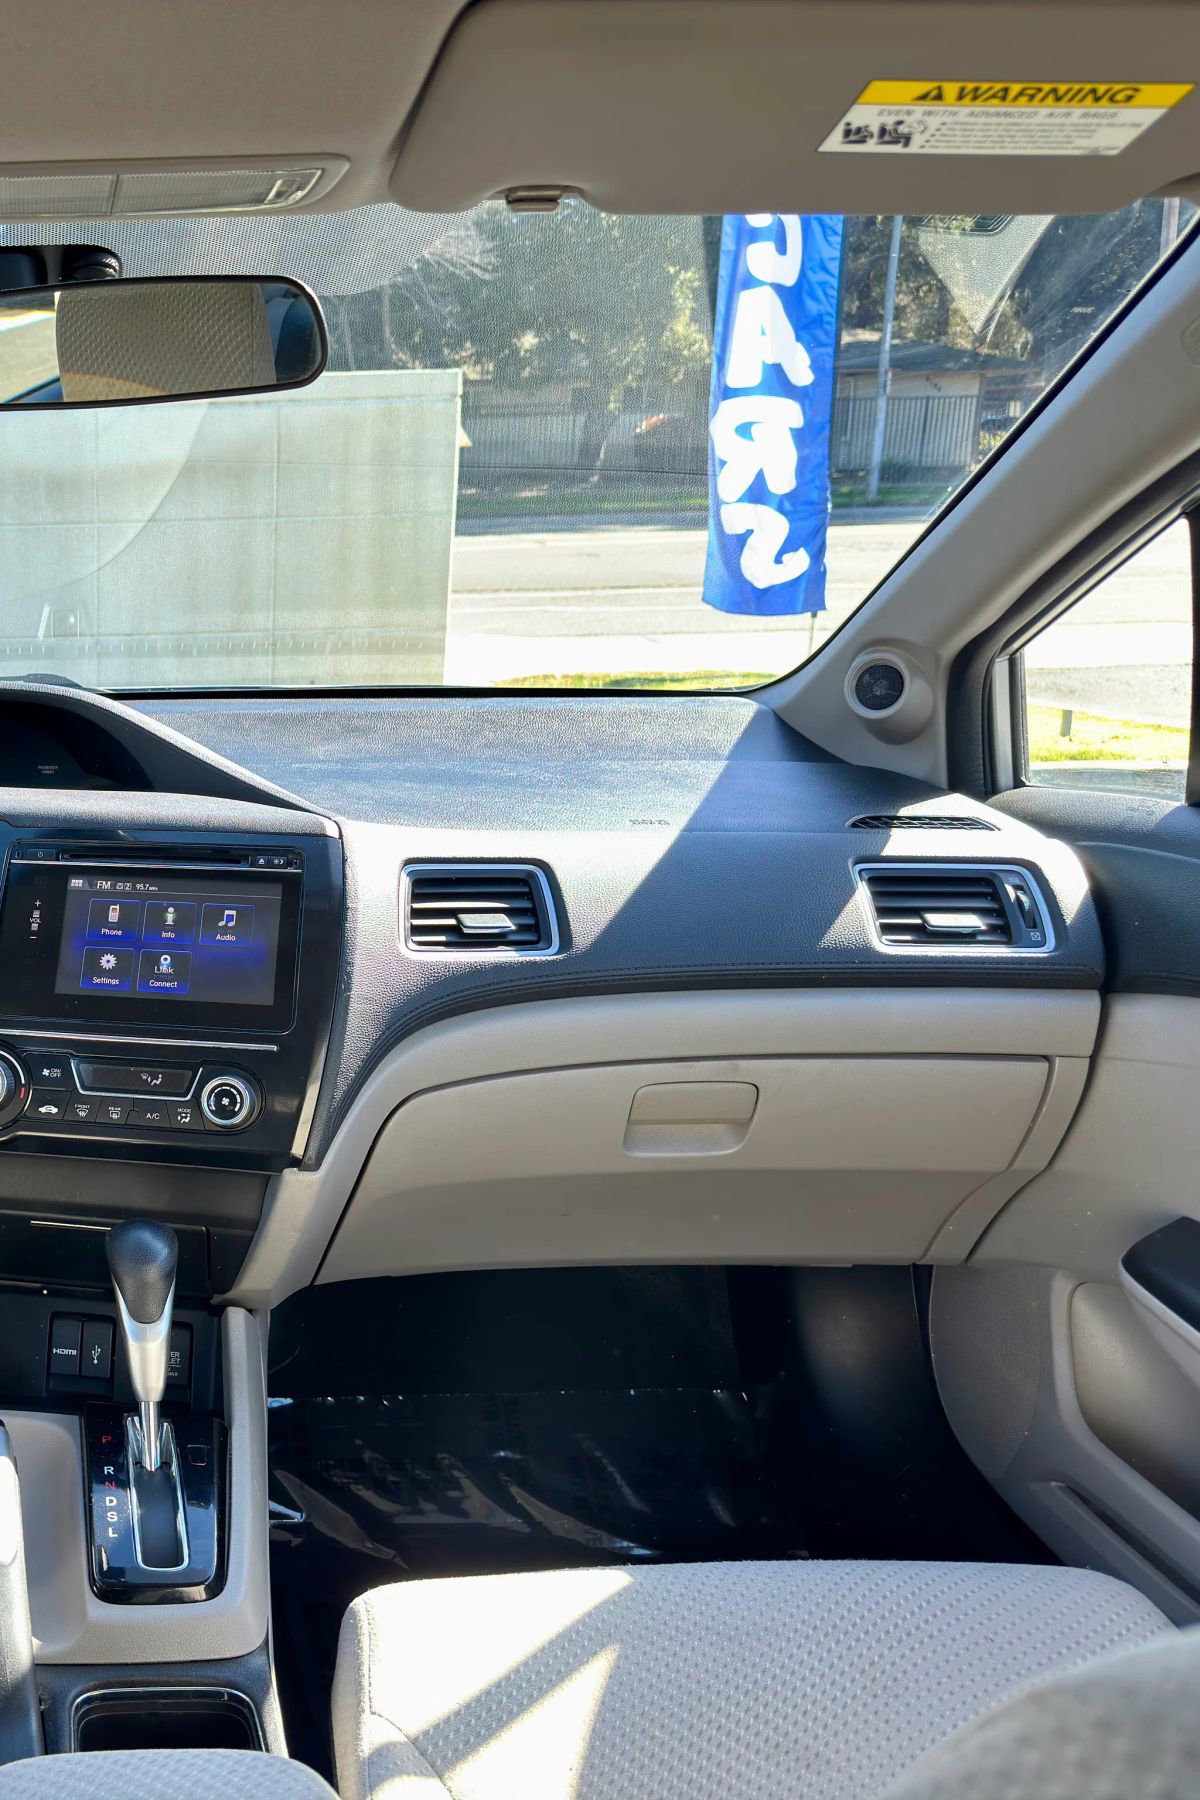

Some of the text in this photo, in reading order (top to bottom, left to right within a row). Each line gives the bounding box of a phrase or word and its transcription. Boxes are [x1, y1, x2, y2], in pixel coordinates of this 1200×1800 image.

[955, 86, 1142, 104] WARNING
[877, 109, 914, 117] EVEN
[922, 109, 959, 117] WITH
[966, 109, 1040, 119] ADVANCED
[1044, 110, 1074, 119] AIR
[97, 881, 111, 890] FM
[101, 927, 123, 937] Phone
[161, 930, 176, 939] Info
[215, 933, 236, 942] Audio
[92, 976, 120, 987] Settings
[149, 979, 178, 988] Connect
[146, 1112, 160, 1120] A/C
[101, 1435, 112, 1444] P
[103, 1466, 115, 1475] R
[104, 1481, 116, 1489] N
[105, 1496, 117, 1506] D
[107, 1512, 118, 1522] S
[108, 1527, 118, 1537] L
